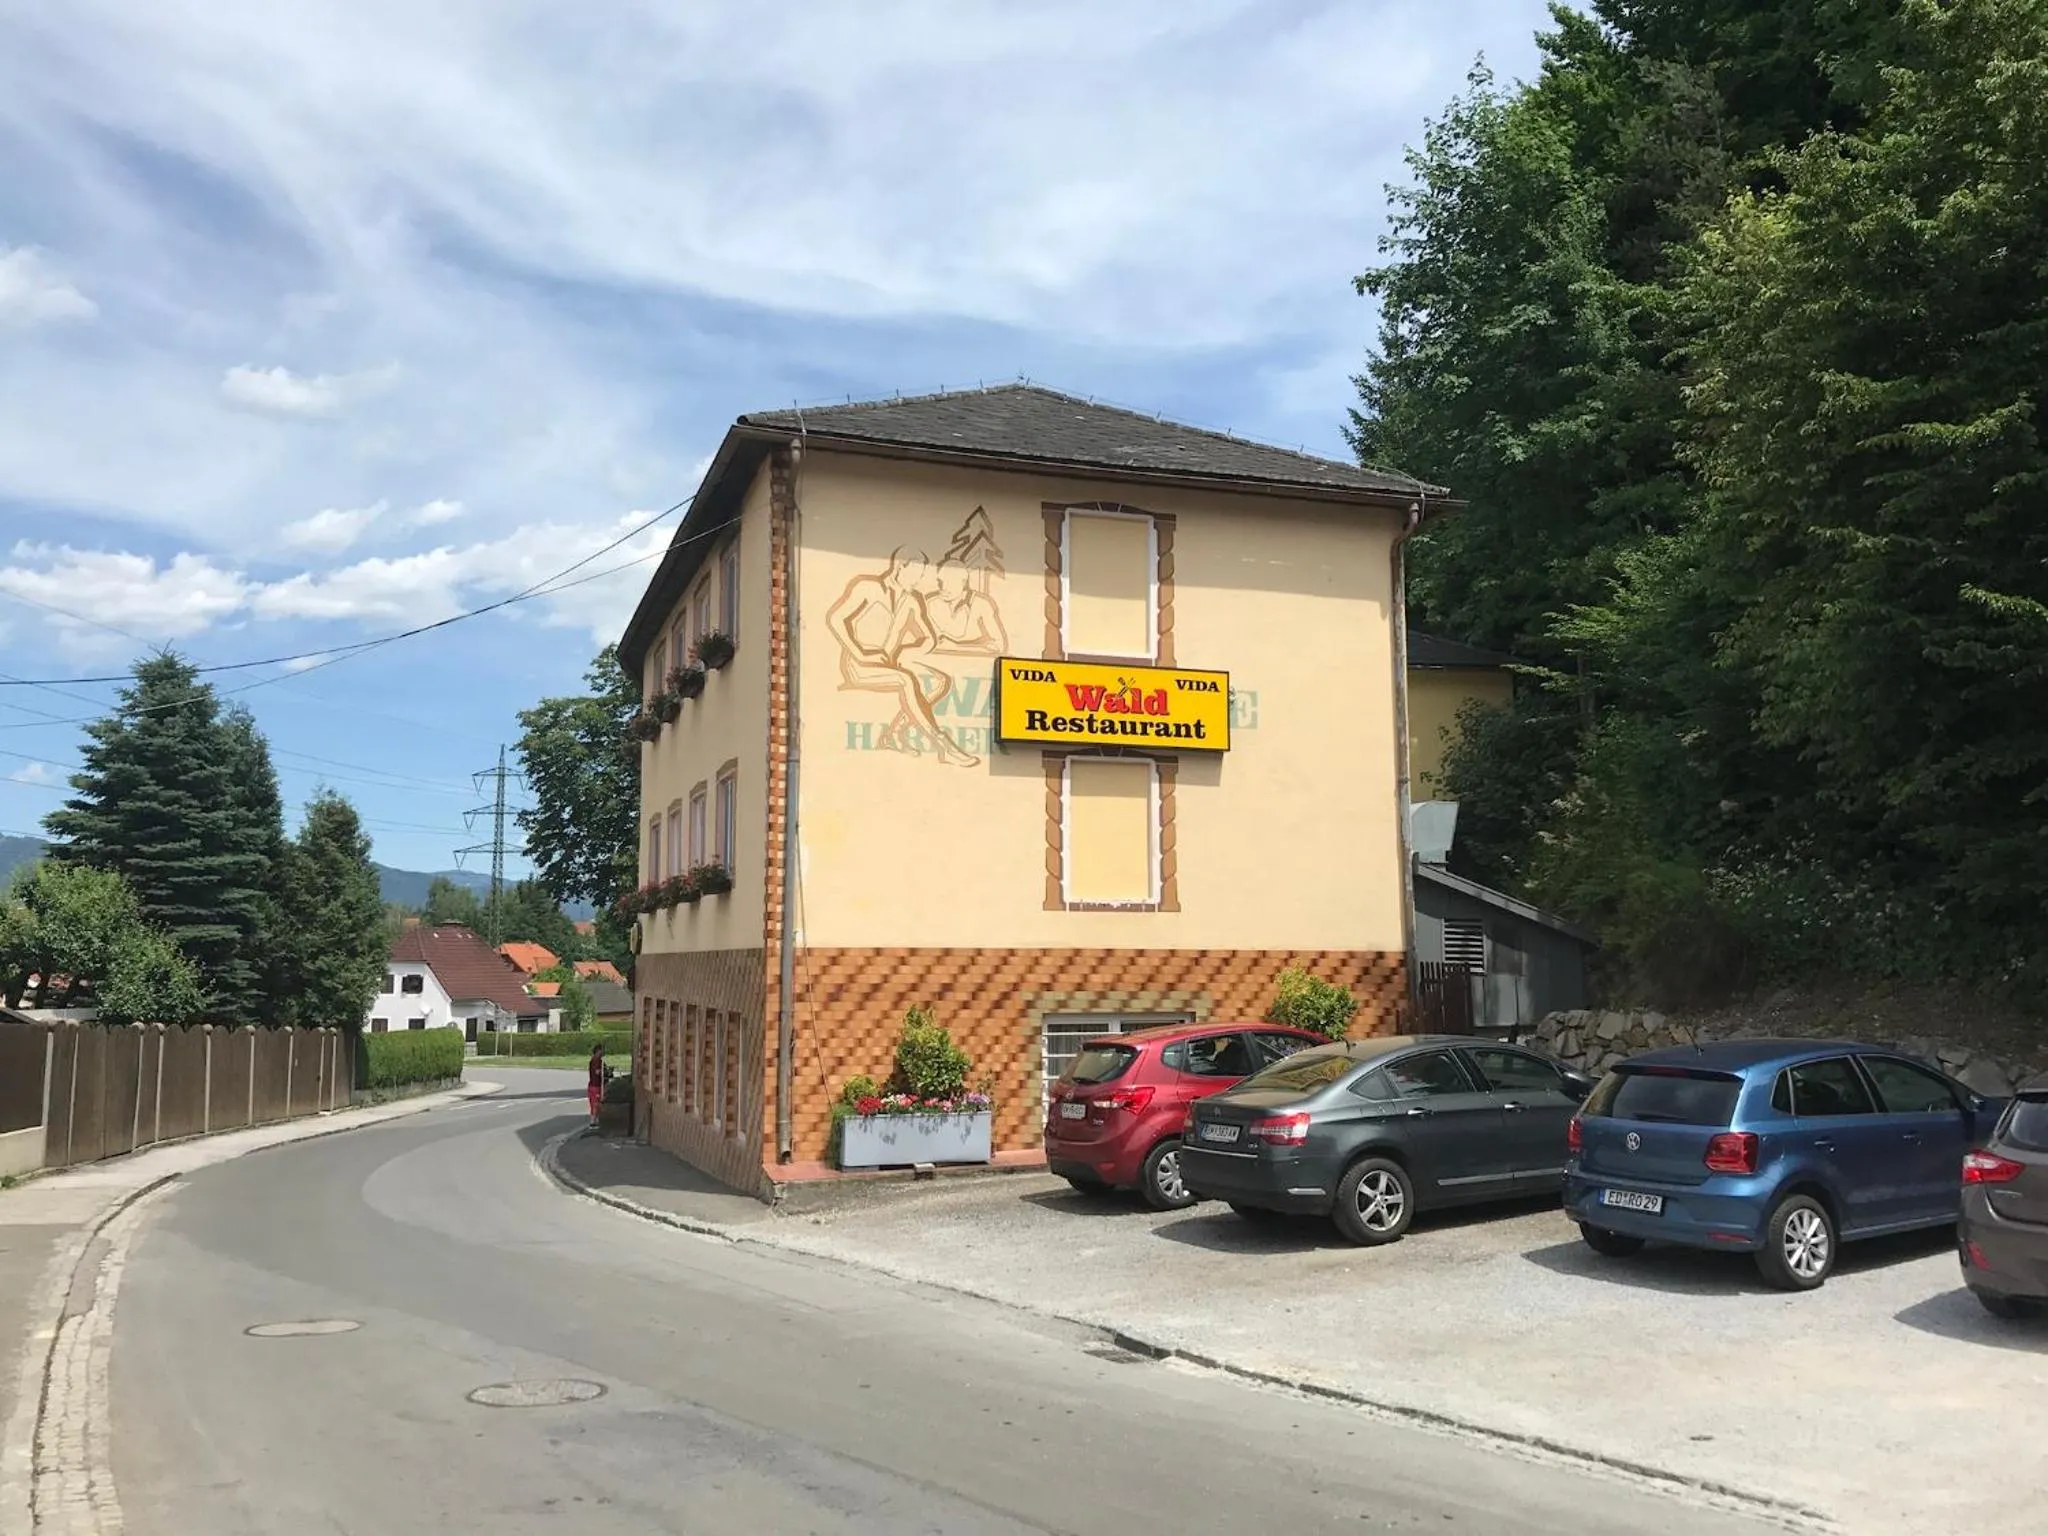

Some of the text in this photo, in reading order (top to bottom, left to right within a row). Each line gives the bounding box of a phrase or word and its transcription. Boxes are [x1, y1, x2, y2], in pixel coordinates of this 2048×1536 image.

[1009, 668, 1057, 683] VIDA
[1175, 678, 1221, 693] VIDA
[1064, 683, 1170, 715] Wald
[1025, 709, 1207, 739] Restaurant
